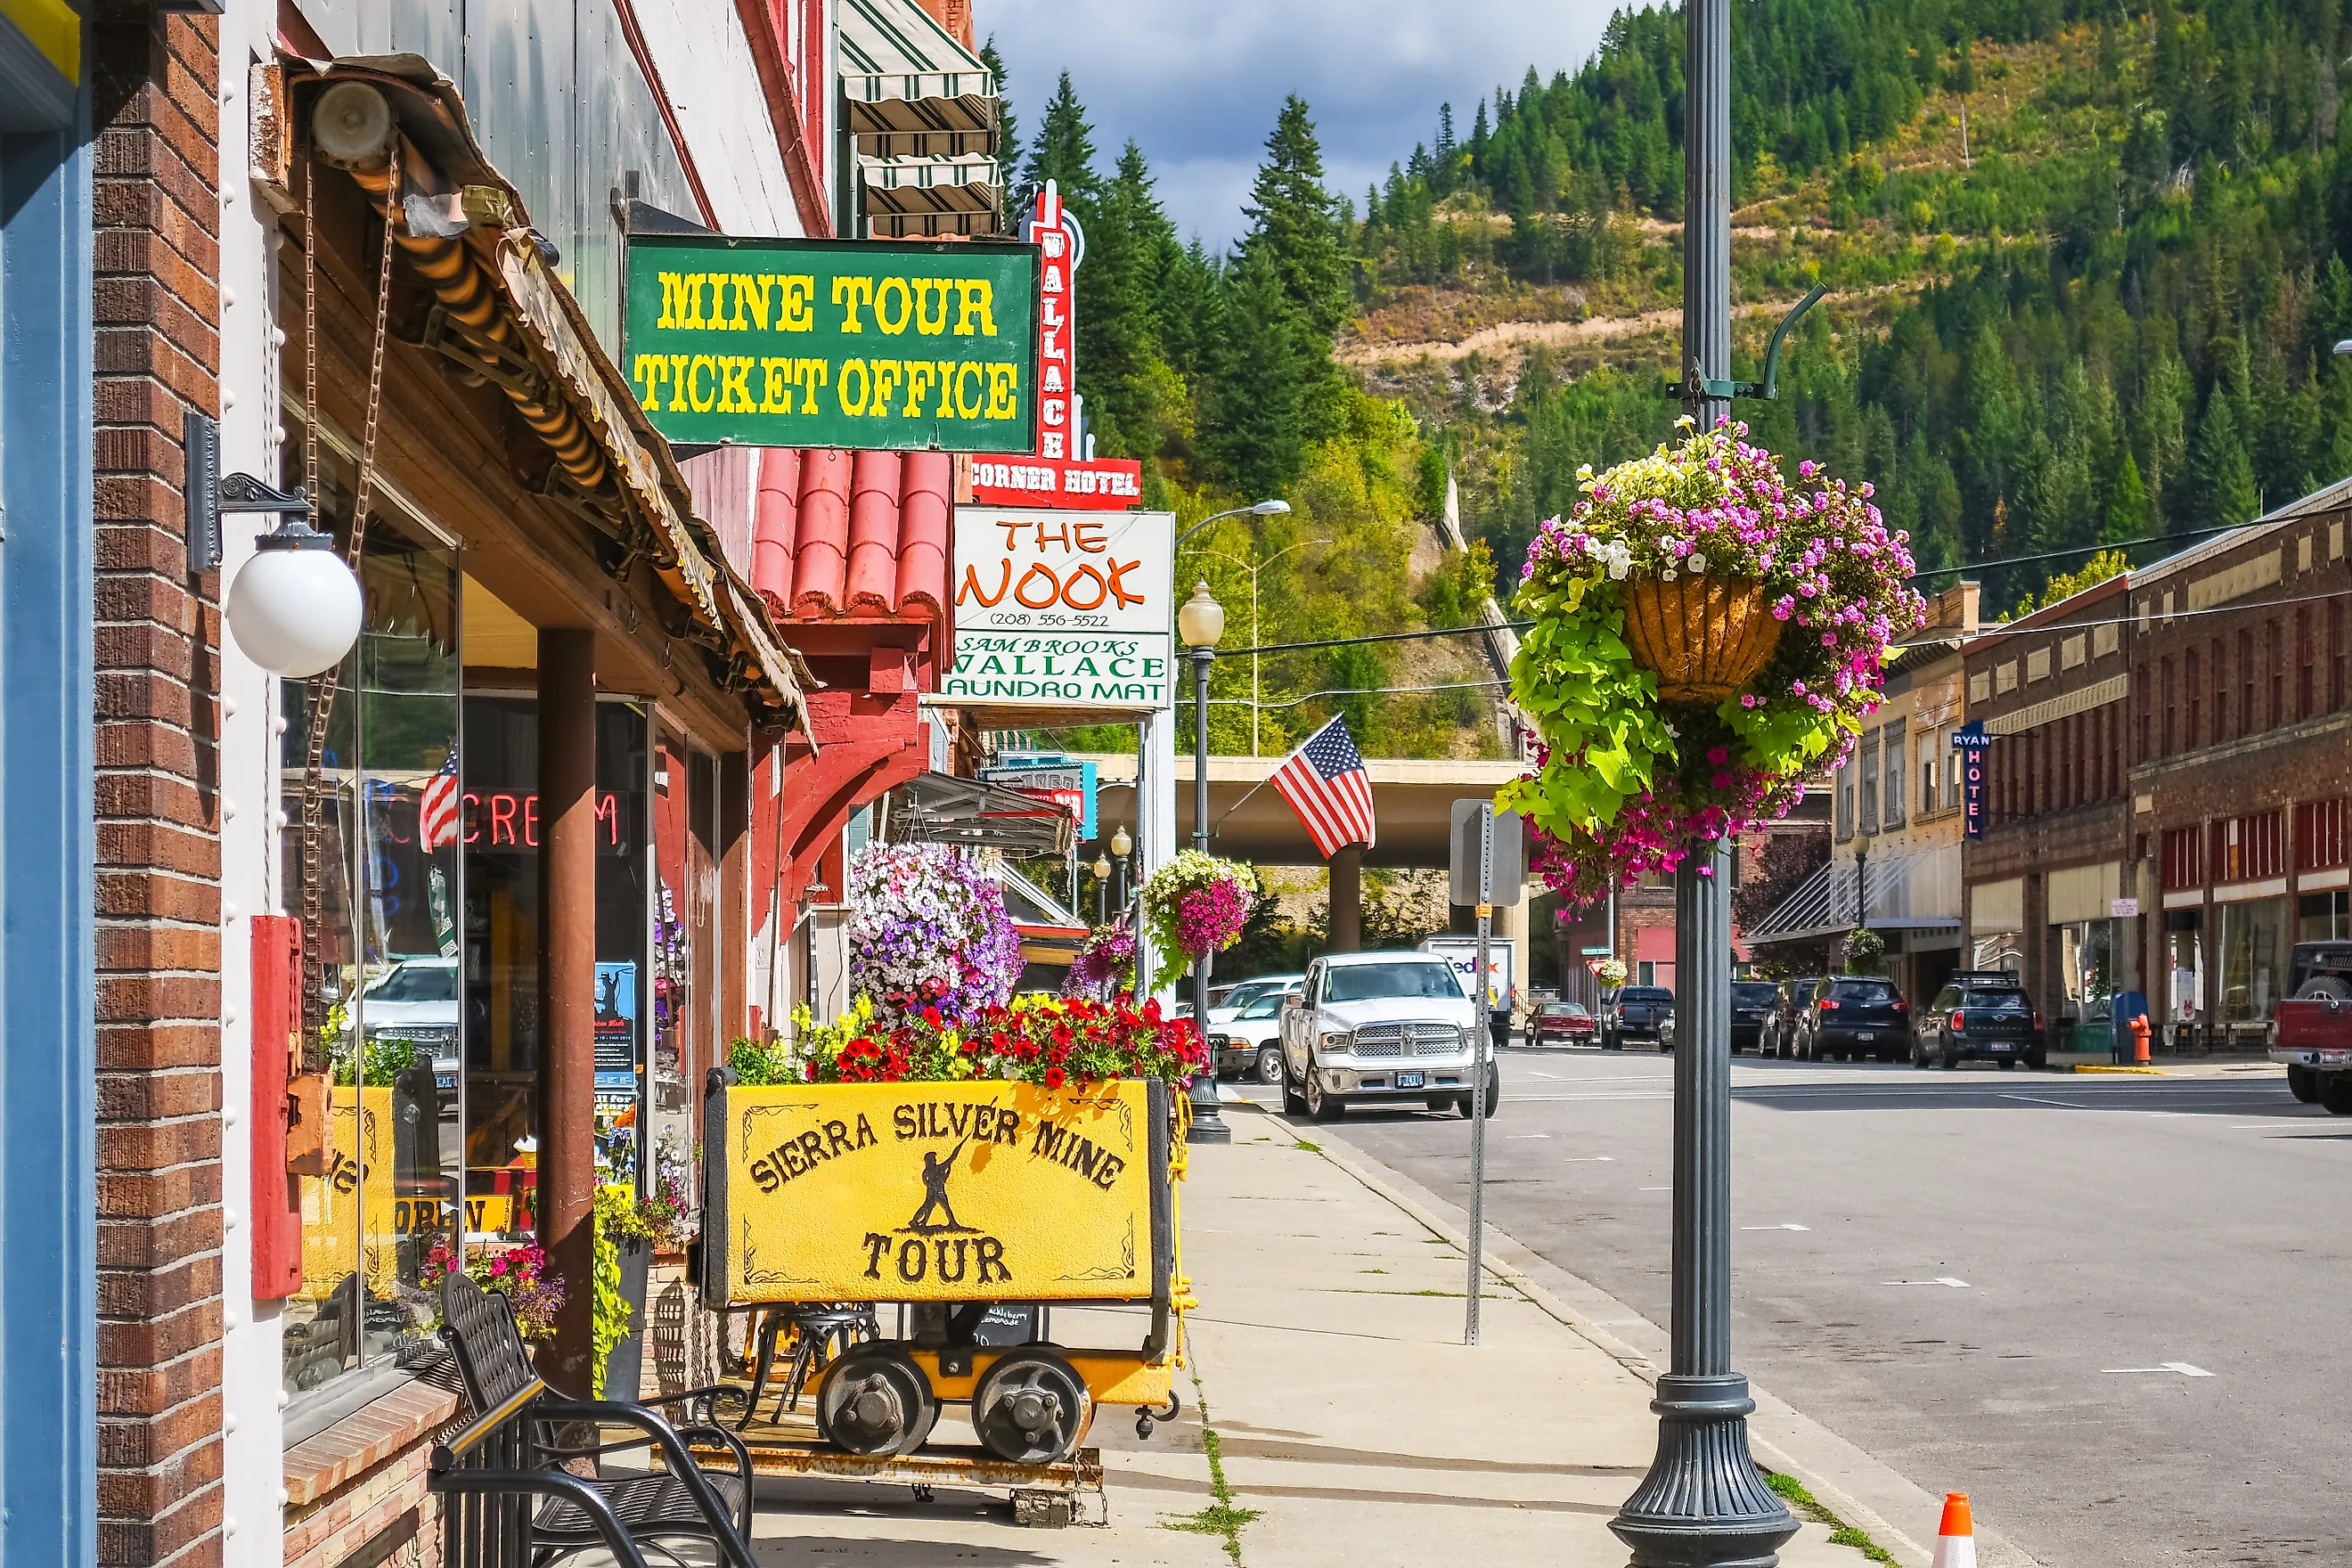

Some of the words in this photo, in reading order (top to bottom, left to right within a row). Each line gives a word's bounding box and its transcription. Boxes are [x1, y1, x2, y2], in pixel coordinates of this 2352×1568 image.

[657, 272, 814, 331] MINE
[832, 276, 997, 337] TOUR
[1042, 232, 1066, 458] WALLACE
[634, 354, 828, 414] TICKET
[837, 358, 1017, 420] OFFICE
[970, 462, 1057, 491] CORNER
[1064, 470, 1139, 496] HOTEL
[996, 520, 1108, 552] THE
[955, 557, 1145, 610] NOOK
[990, 613, 1031, 625] (208)
[1038, 615, 1109, 627] 556-5522
[957, 637, 1022, 653] SAM
[1024, 640, 1139, 657] BROOKS
[943, 679, 1082, 698] AUNDRO
[1091, 683, 1165, 701] MAT
[1953, 736, 1989, 745] RYAN
[1968, 750, 1980, 834] HOTEL
[462, 794, 617, 847] CREM
[1447, 957, 1499, 974] edx
[750, 1112, 878, 1196] SIERRA
[893, 1101, 1020, 1147] SILVER
[1033, 1121, 1127, 1192] MINE
[862, 1232, 1013, 1285] TOUR
